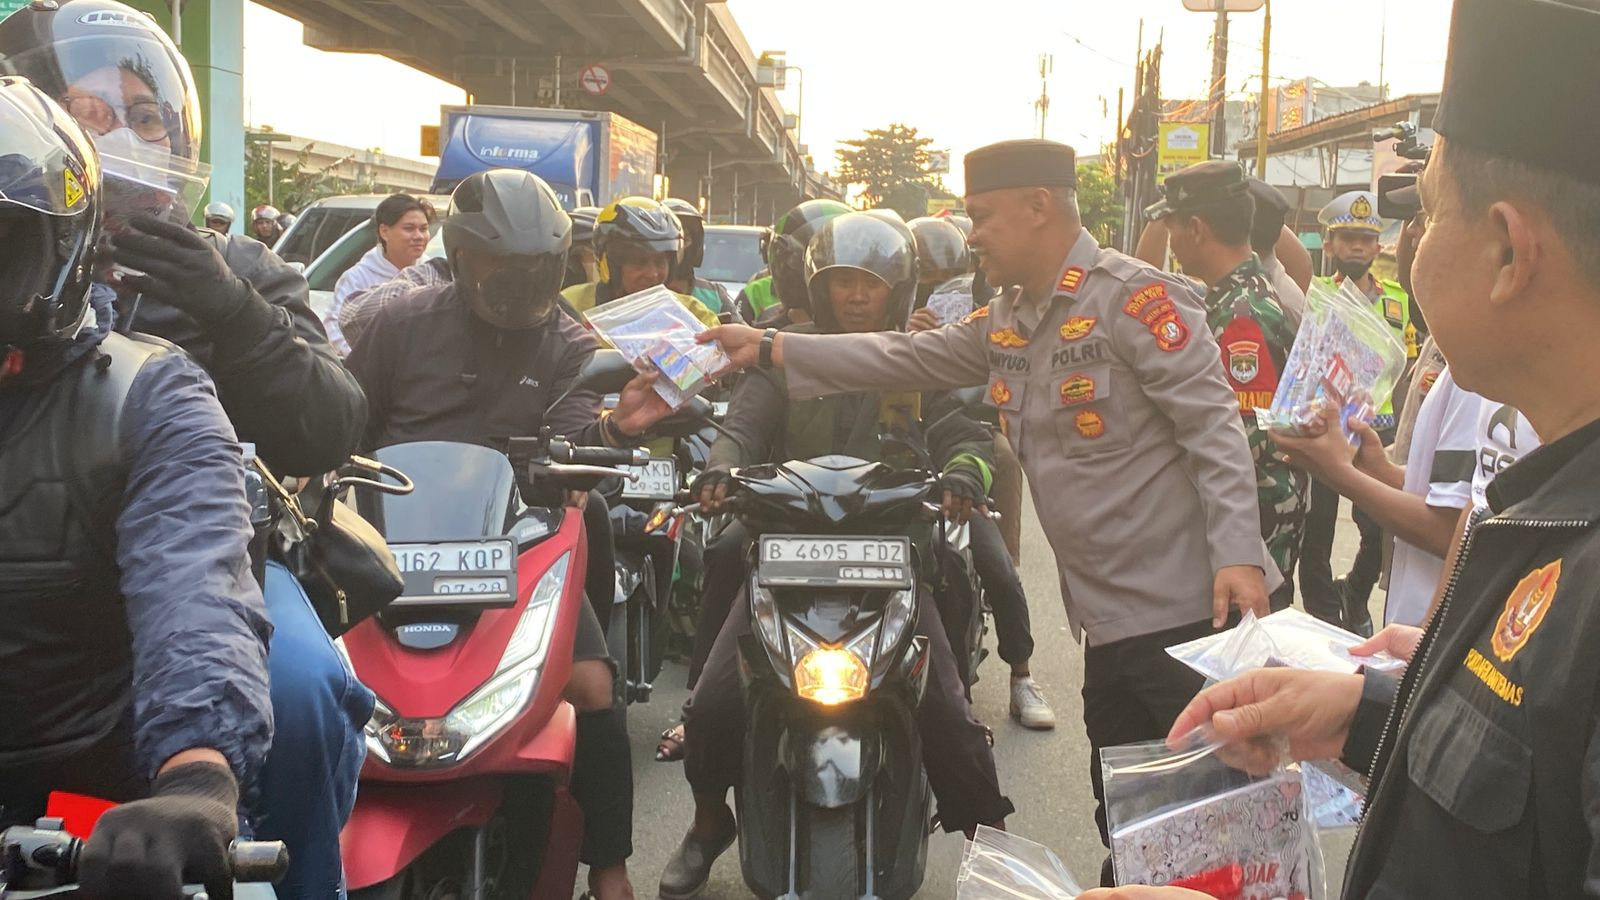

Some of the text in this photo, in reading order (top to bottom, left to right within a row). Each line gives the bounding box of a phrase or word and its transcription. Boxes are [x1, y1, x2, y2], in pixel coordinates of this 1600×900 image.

[480, 146, 538, 159] informa
[1051, 342, 1103, 368] POLRI
[393, 548, 503, 572] 162 KQP
[769, 543, 901, 562] B 4695 FDZ
[404, 624, 451, 633] HONDA
